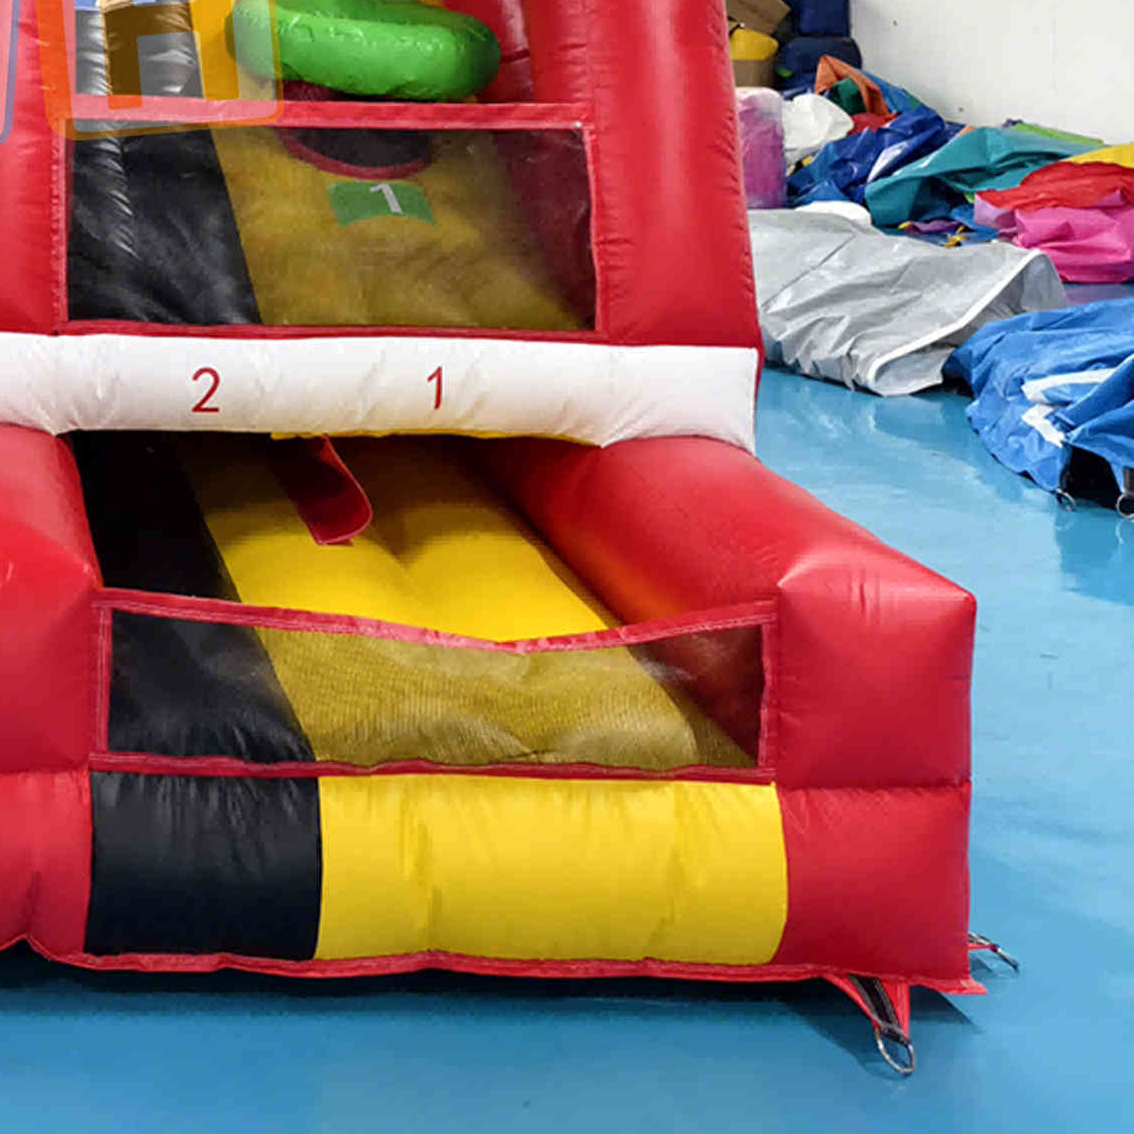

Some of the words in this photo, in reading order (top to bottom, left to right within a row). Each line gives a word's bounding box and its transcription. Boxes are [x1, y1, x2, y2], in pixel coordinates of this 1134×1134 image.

[369, 183, 403, 214] 1
[191, 366, 221, 413] 2
[427, 365, 443, 411] 1
